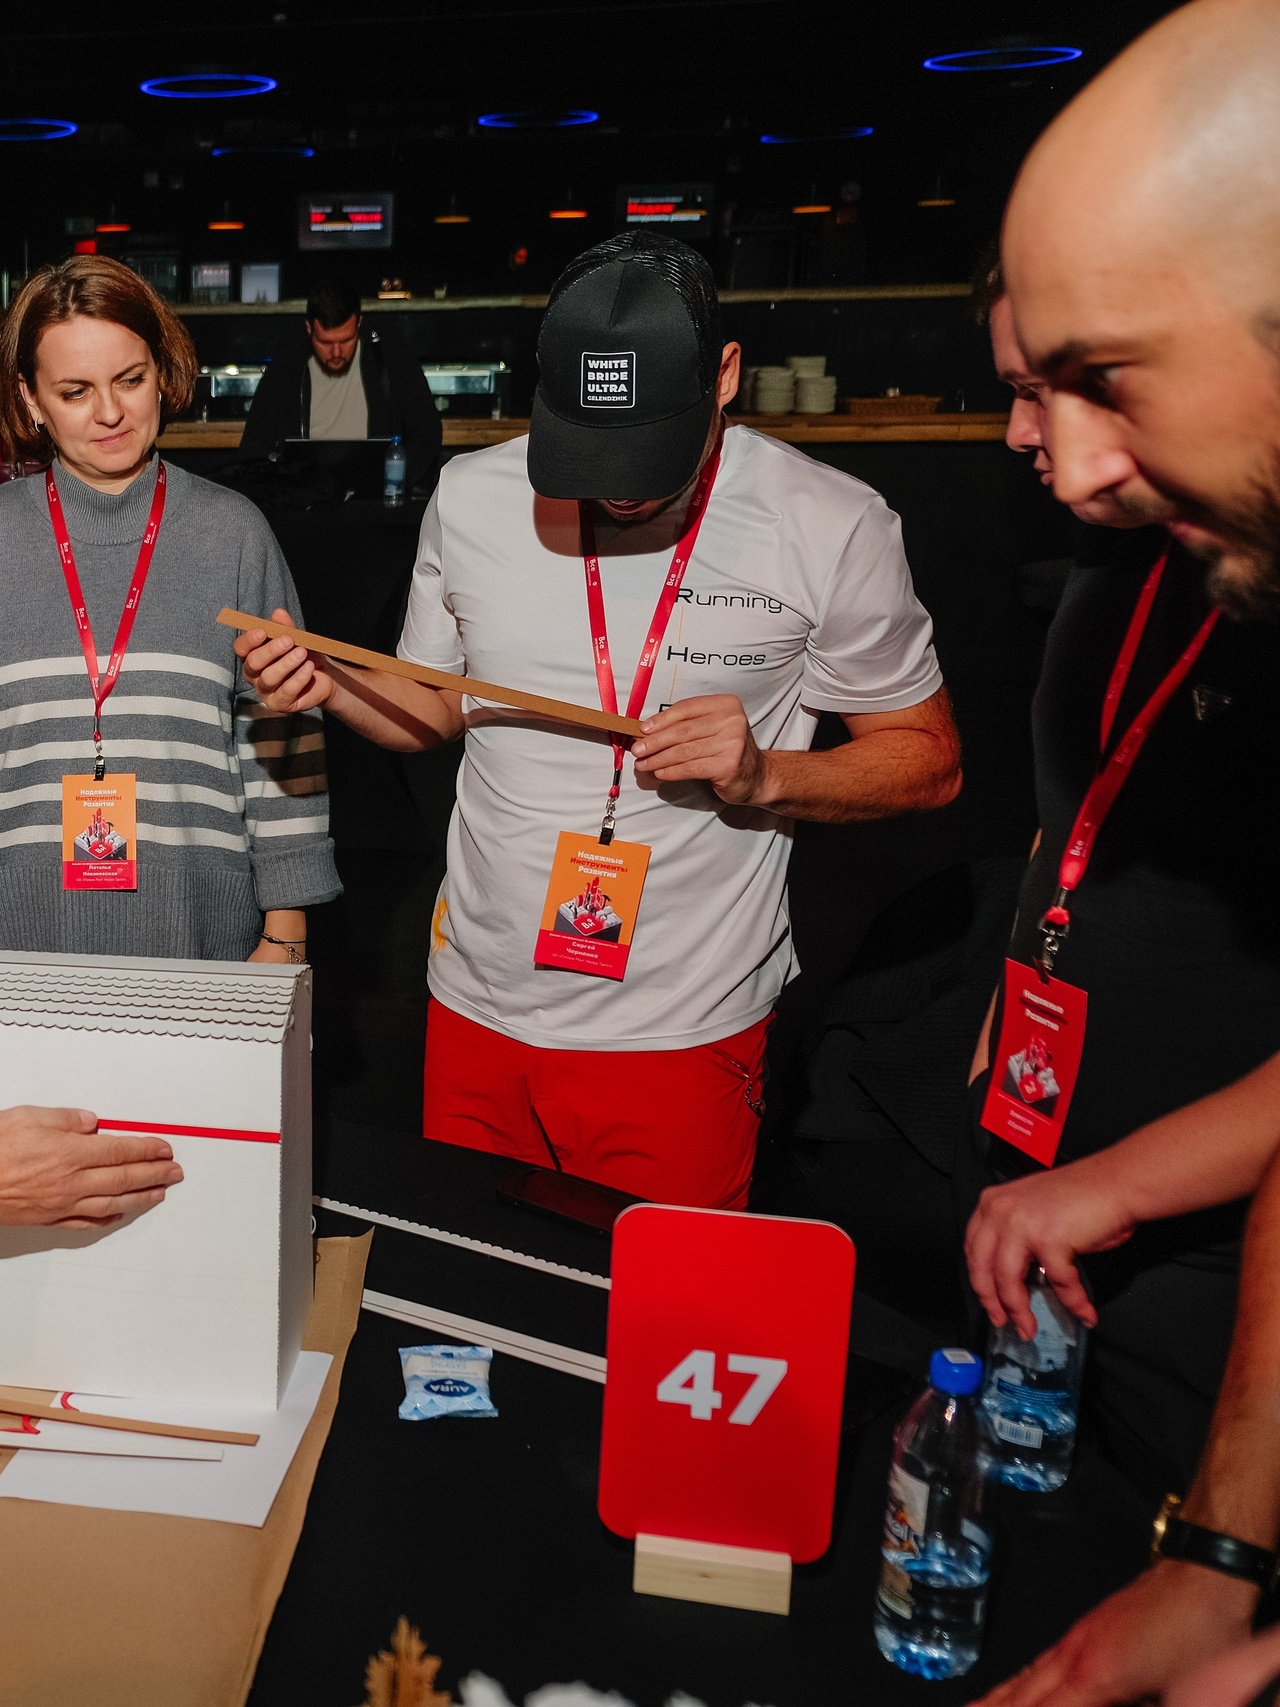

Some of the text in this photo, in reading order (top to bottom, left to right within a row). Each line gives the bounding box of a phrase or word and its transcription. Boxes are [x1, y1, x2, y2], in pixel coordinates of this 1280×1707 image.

[587, 359, 628, 369] WHITE
[587, 371, 628, 381] BRIDE
[587, 384, 628, 392] ULTRA
[666, 573, 677, 587] Все
[675, 588, 783, 614] Running
[598, 636, 606, 649] Все
[640, 653, 650, 667] Все
[666, 645, 766, 666] Heroes
[577, 850, 624, 865] Надежные
[570, 857, 628, 873] Инструменты
[578, 865, 617, 878] Развития
[572, 941, 596, 951] Сергей
[429, 1384, 470, 1392] AURA
[657, 1349, 788, 1426] 47
